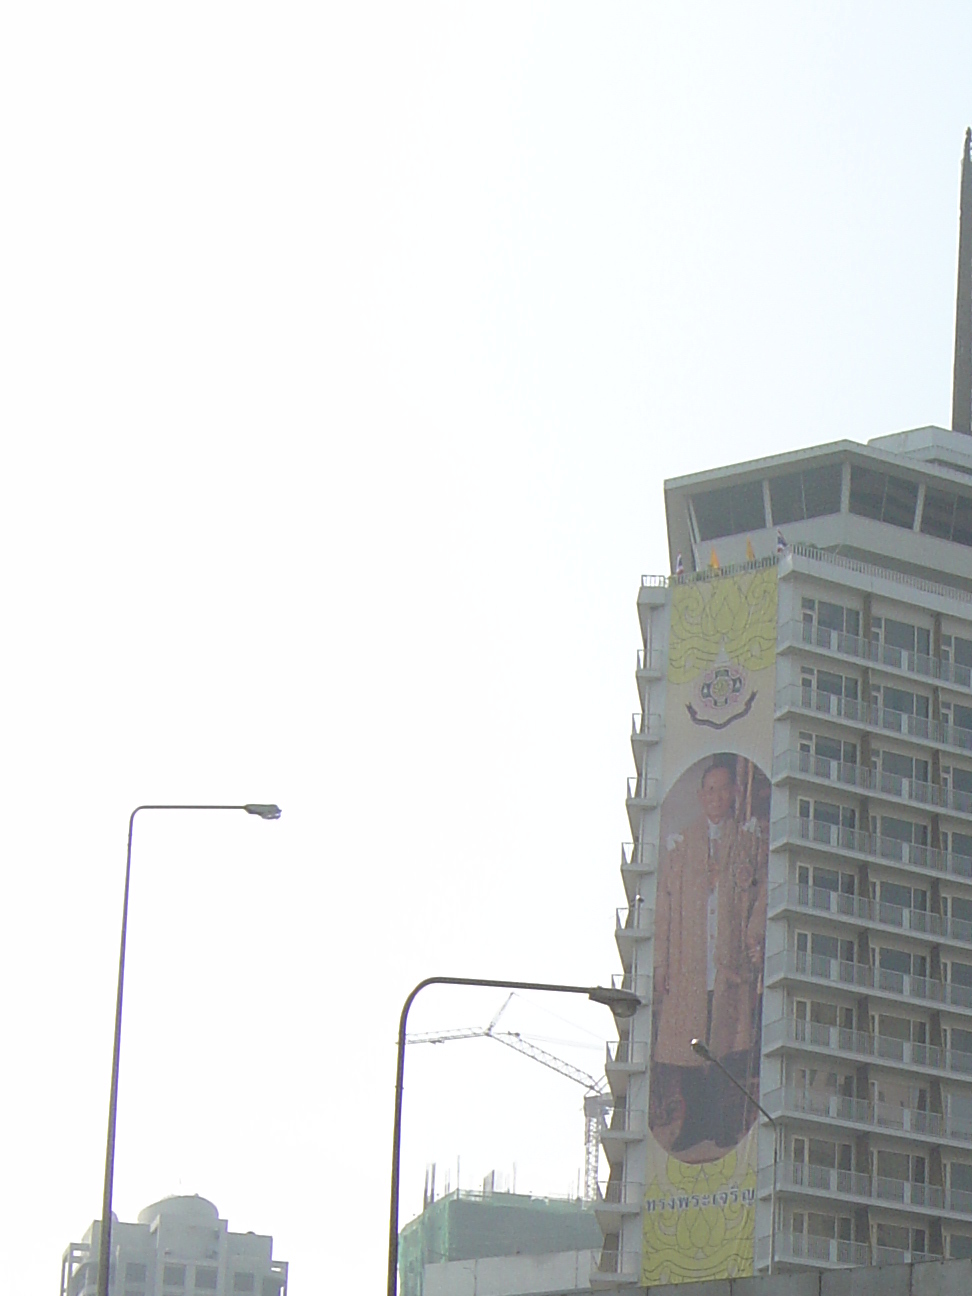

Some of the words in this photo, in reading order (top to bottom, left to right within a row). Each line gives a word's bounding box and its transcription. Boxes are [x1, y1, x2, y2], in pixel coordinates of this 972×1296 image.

[646, 1182, 756, 1212] ทรงพระเจริญ
